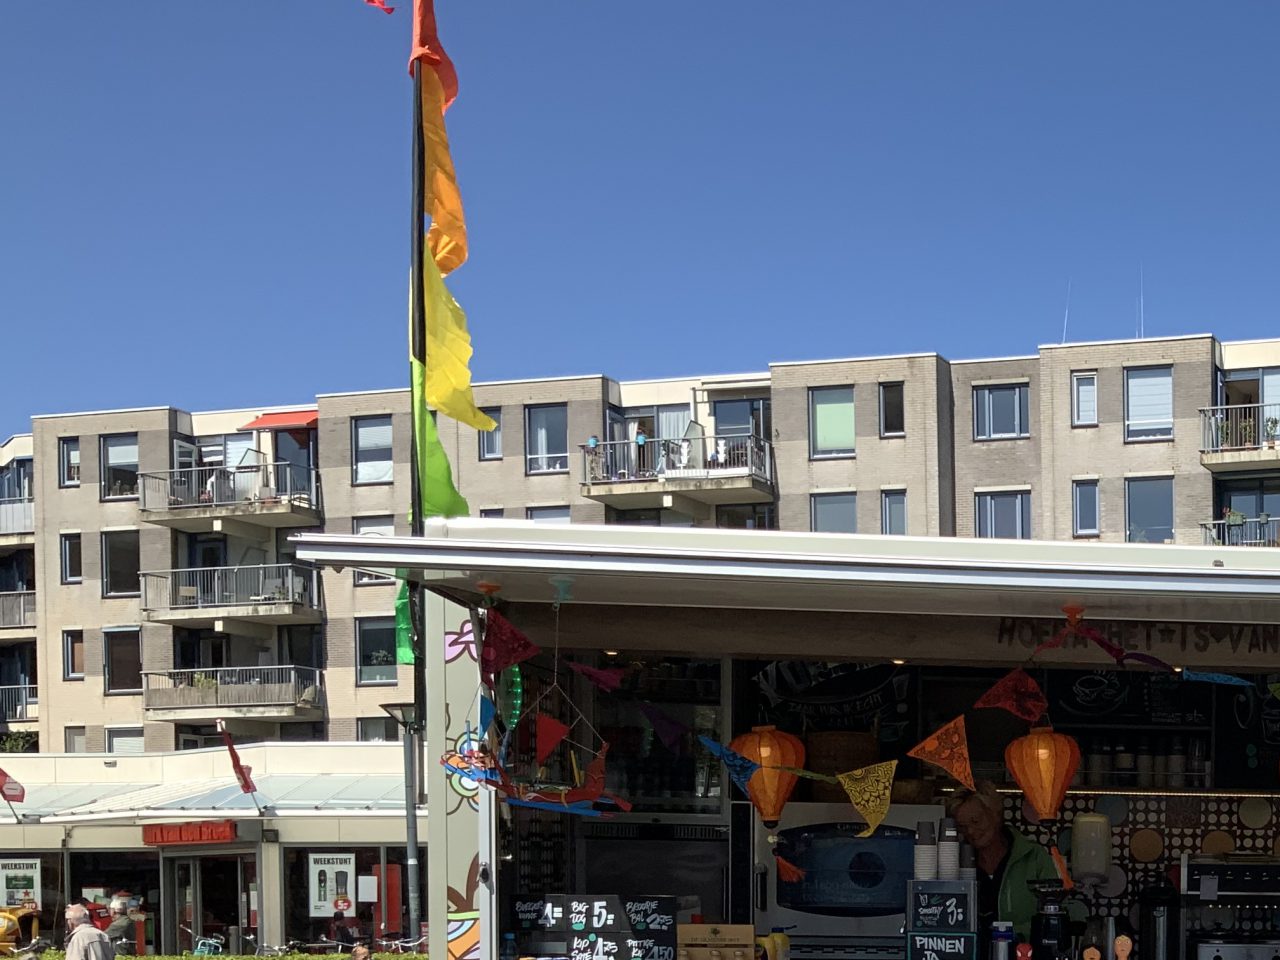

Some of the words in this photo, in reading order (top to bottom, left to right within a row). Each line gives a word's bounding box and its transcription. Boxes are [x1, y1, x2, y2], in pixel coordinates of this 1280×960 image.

[1178, 623, 1209, 652] IS
[313, 857, 352, 865] WEEKSTUNT
[571, 901, 590, 912] BIG
[914, 936, 965, 954] PINNEN
